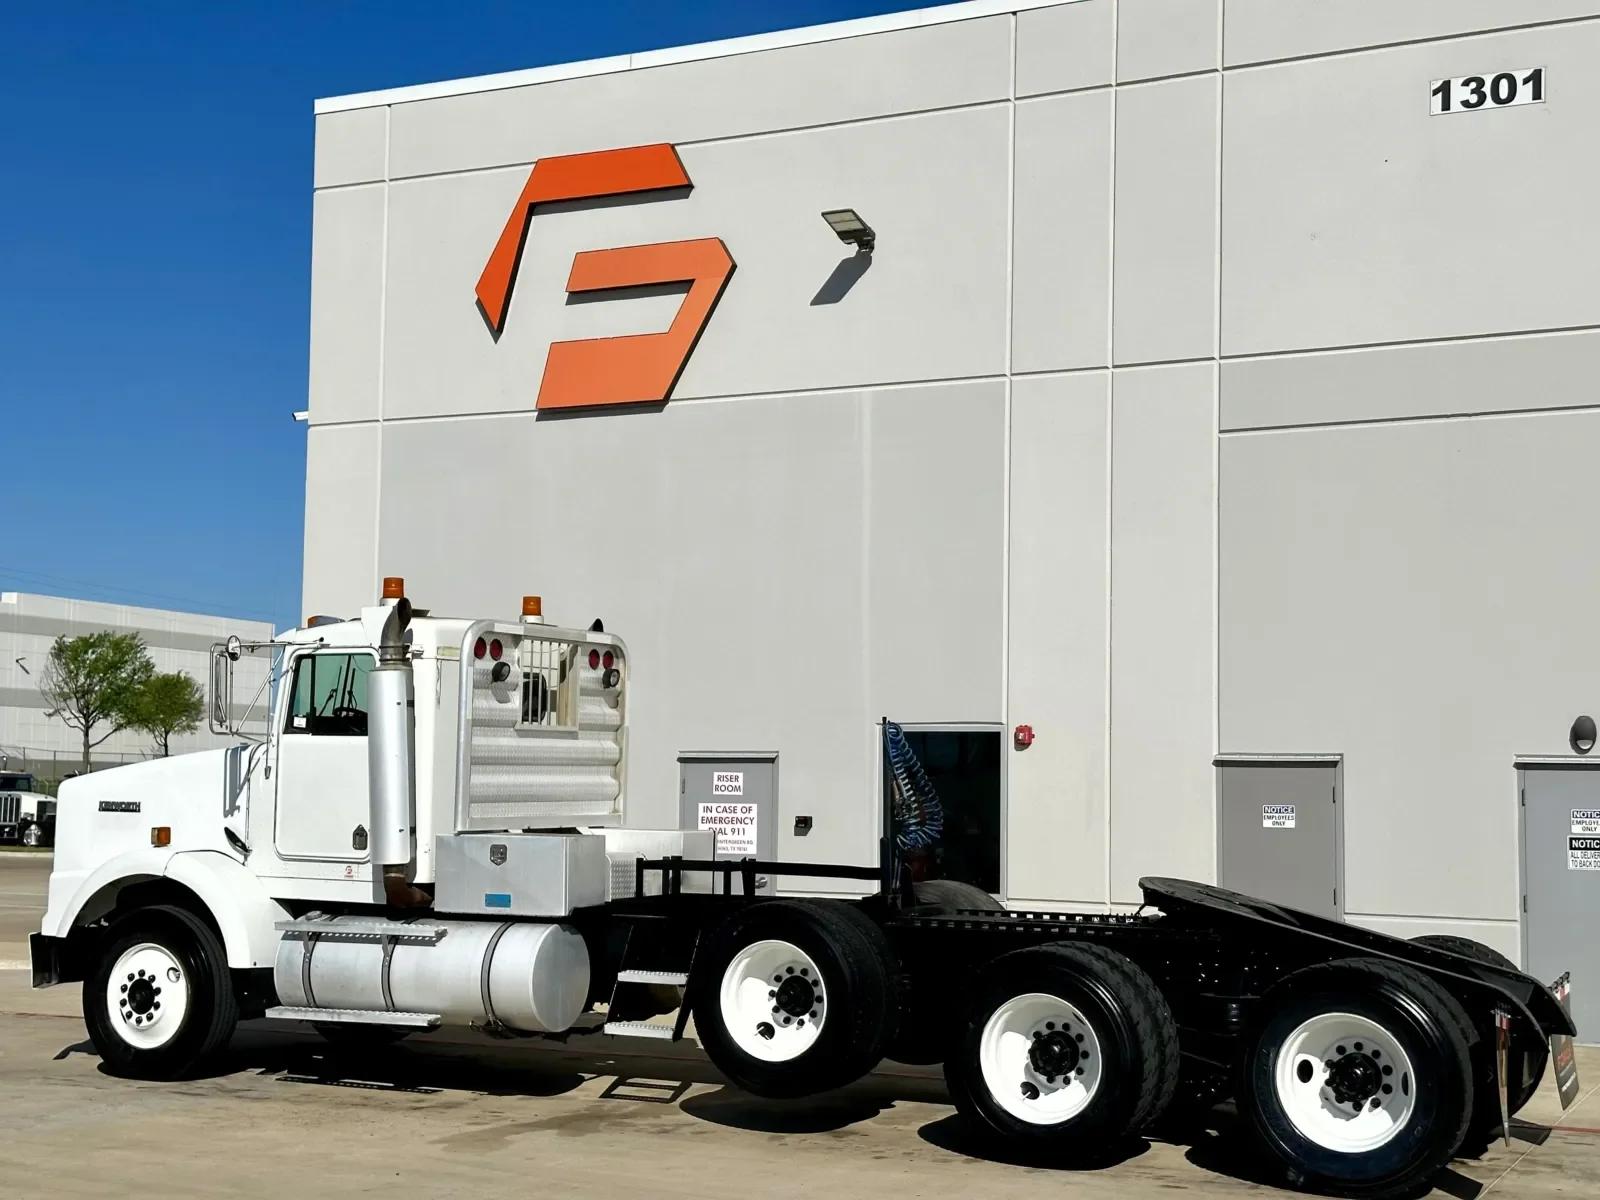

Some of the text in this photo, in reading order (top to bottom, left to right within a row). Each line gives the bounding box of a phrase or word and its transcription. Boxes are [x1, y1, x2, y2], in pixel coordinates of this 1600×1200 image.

[1431, 68, 1542, 112] 1301
[716, 774, 740, 782] RISER
[714, 784, 742, 792] ROOM
[703, 805, 753, 814] IN CASE OF
[1264, 806, 1295, 814] NOTICE
[1573, 811, 1600, 819] NOTIC
[700, 816, 755, 825] EMERGENCY
[730, 827, 746, 836] 911
[1572, 839, 1600, 849] NOTIC
[1570, 851, 1580, 859] ALL
[1570, 859, 1578, 868] TO
[1578, 859, 1593, 868] BACK
